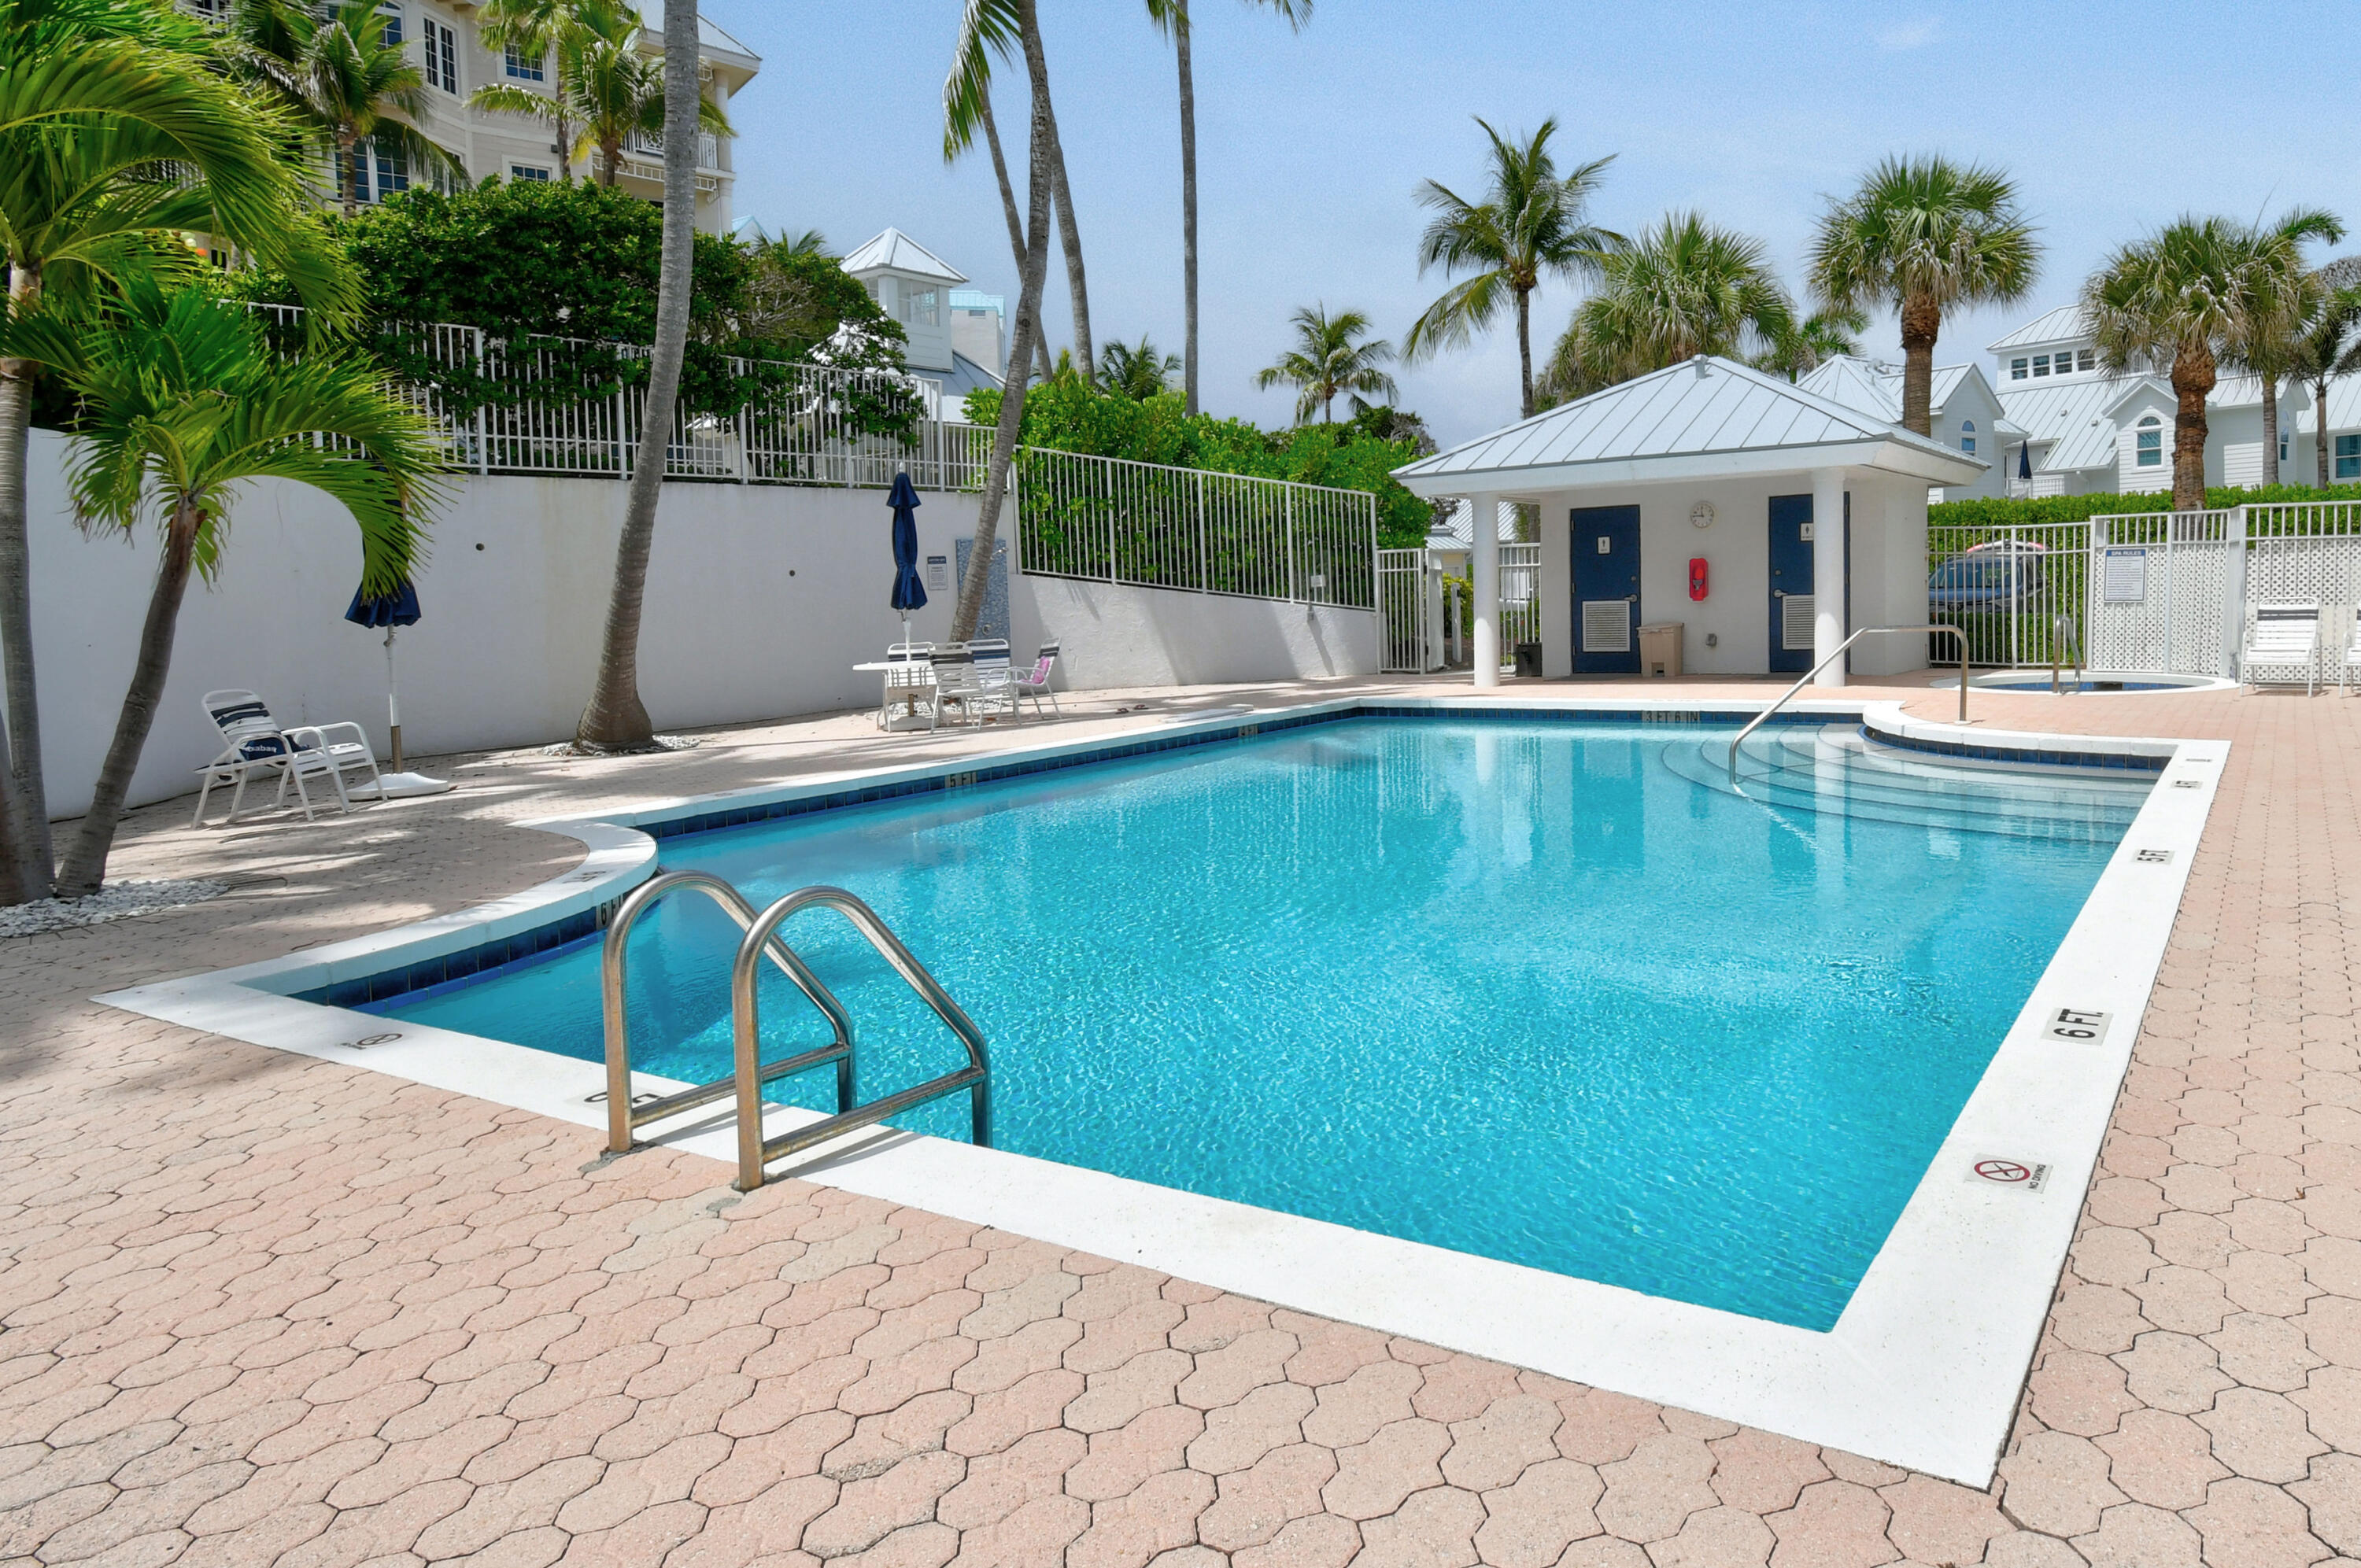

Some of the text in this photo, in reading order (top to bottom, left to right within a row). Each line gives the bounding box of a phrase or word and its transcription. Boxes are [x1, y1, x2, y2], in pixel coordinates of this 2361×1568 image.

[1646, 710, 1698, 723] 3 FT 6 IN
[600, 902, 607, 926] 6
[2052, 1028, 2096, 1039] 6
[2027, 1164, 2046, 1190] NO DIVING
